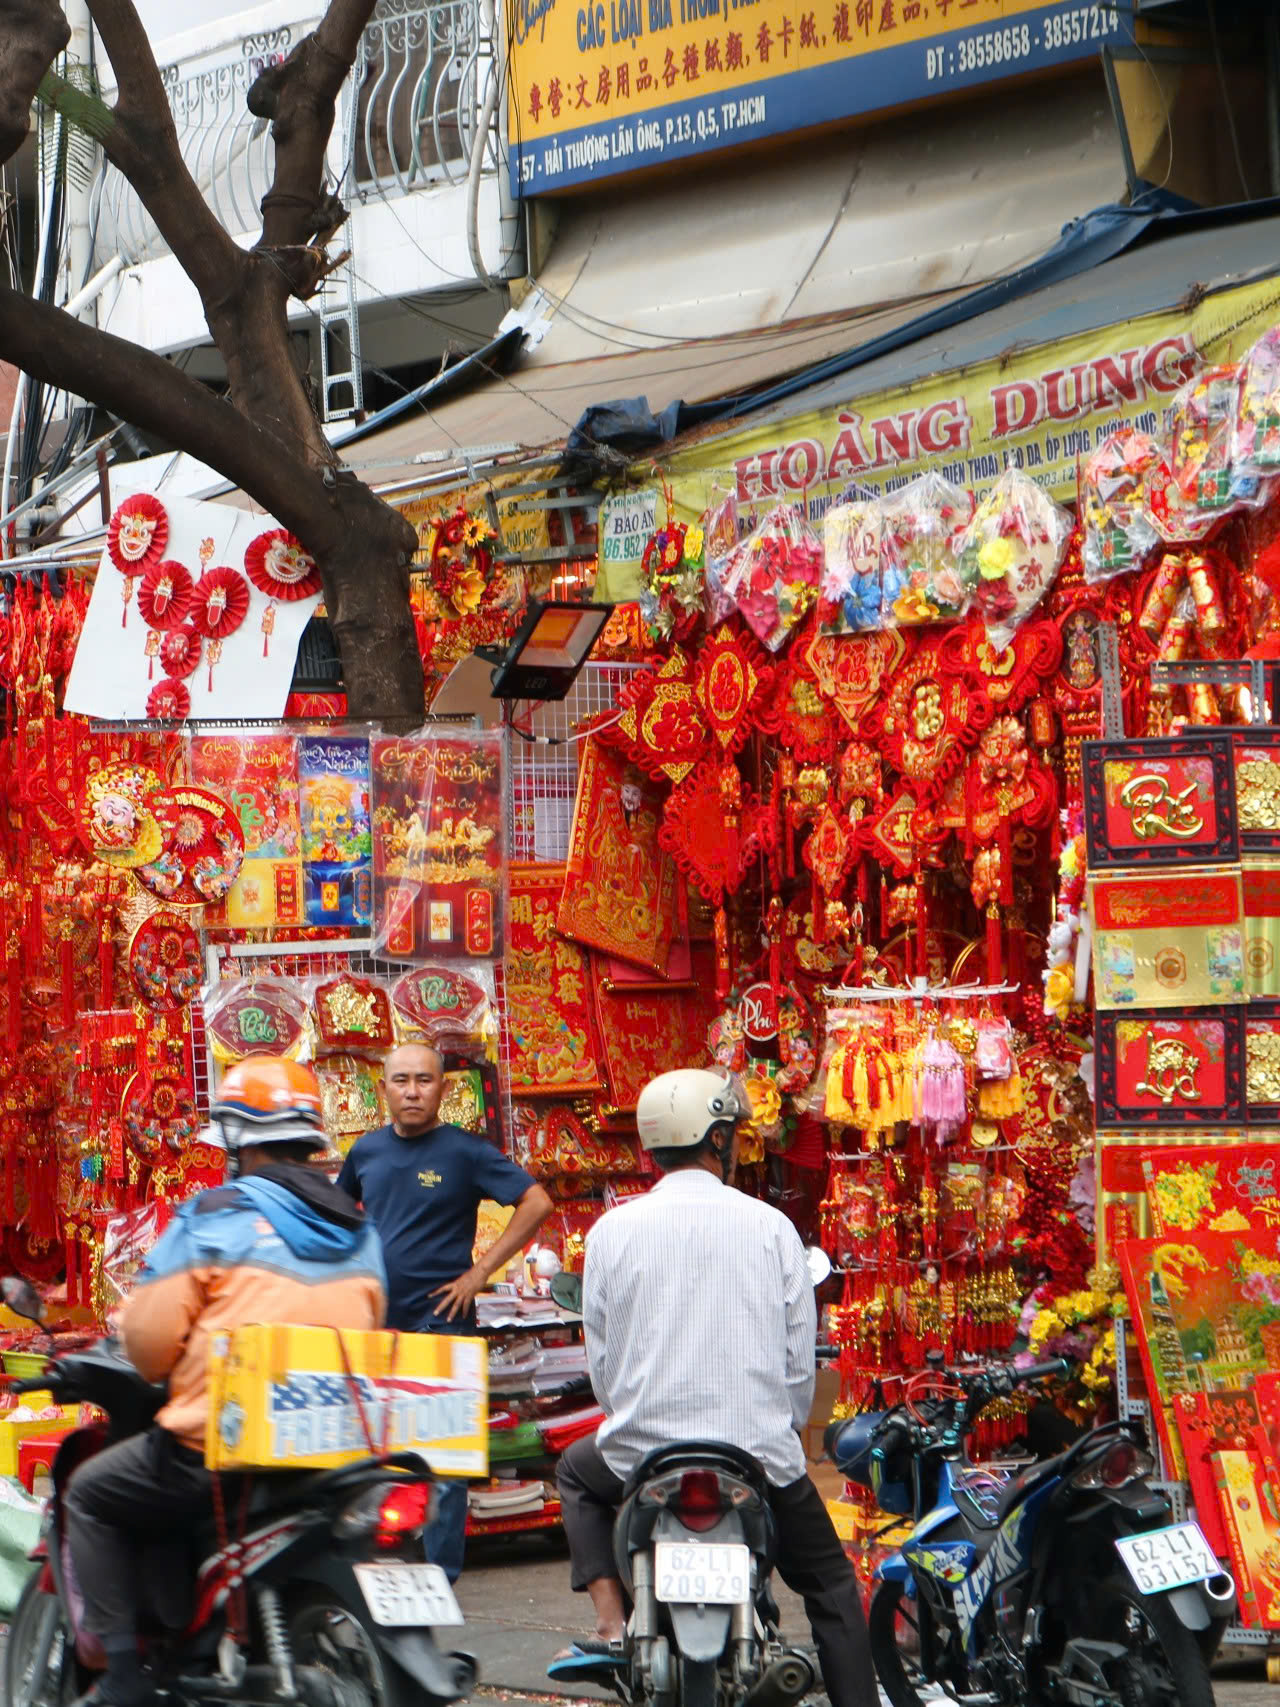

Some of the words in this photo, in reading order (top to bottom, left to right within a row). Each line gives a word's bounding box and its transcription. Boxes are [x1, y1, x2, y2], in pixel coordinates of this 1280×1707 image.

[958, 23, 1031, 73] 38558658
[1043, 5, 1120, 51] 38557214
[545, 138, 564, 176] HẢI
[566, 134, 611, 171] THƯỢNG
[612, 123, 634, 158] LÃN
[637, 119, 664, 152] ÔNG,
[666, 117, 697, 145] P.13,
[698, 107, 720, 141] Q.5,
[722, 95, 767, 133] TP.HCM
[733, 396, 975, 506] HOÀNG
[988, 334, 1204, 442] DUNG
[641, 509, 655, 529] AN
[671, 1548, 732, 1573] 62-L1
[1131, 1530, 1193, 1563] 62-L1
[661, 1574, 744, 1600] 209.29
[1136, 1552, 1218, 1590] 631.52
